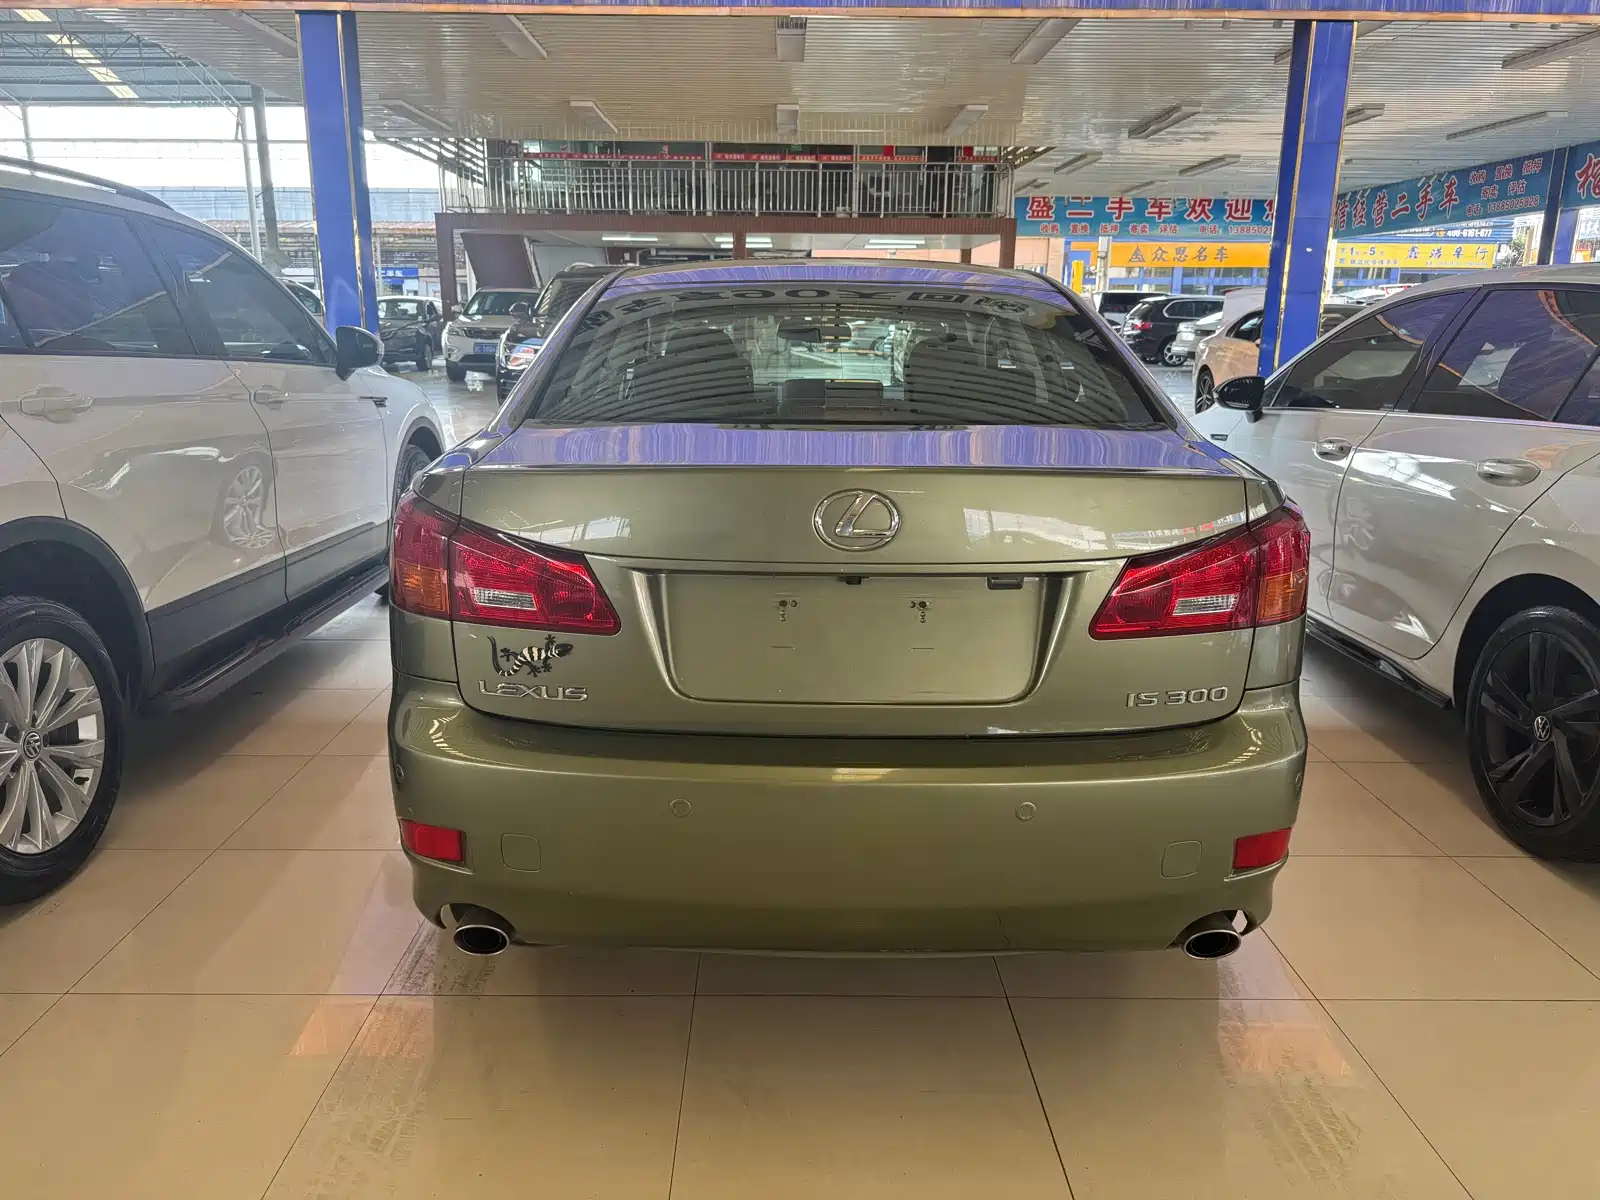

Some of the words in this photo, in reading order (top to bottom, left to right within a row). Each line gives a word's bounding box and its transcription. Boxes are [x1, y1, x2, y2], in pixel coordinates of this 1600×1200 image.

[1469, 169, 1487, 185] 收购
[1507, 179, 1527, 196] 评估
[1334, 177, 1459, 232] 信经营二手车
[1040, 223, 1060, 235] 收购
[1070, 223, 1090, 235] 置换
[1100, 223, 1119, 235] 抵押
[1159, 223, 1178, 235] 评估
[1151, 246, 1229, 262] 众思名车
[478, 679, 589, 702] LEXUS
[1126, 691, 1159, 708] IS
[1164, 686, 1229, 706] 300
